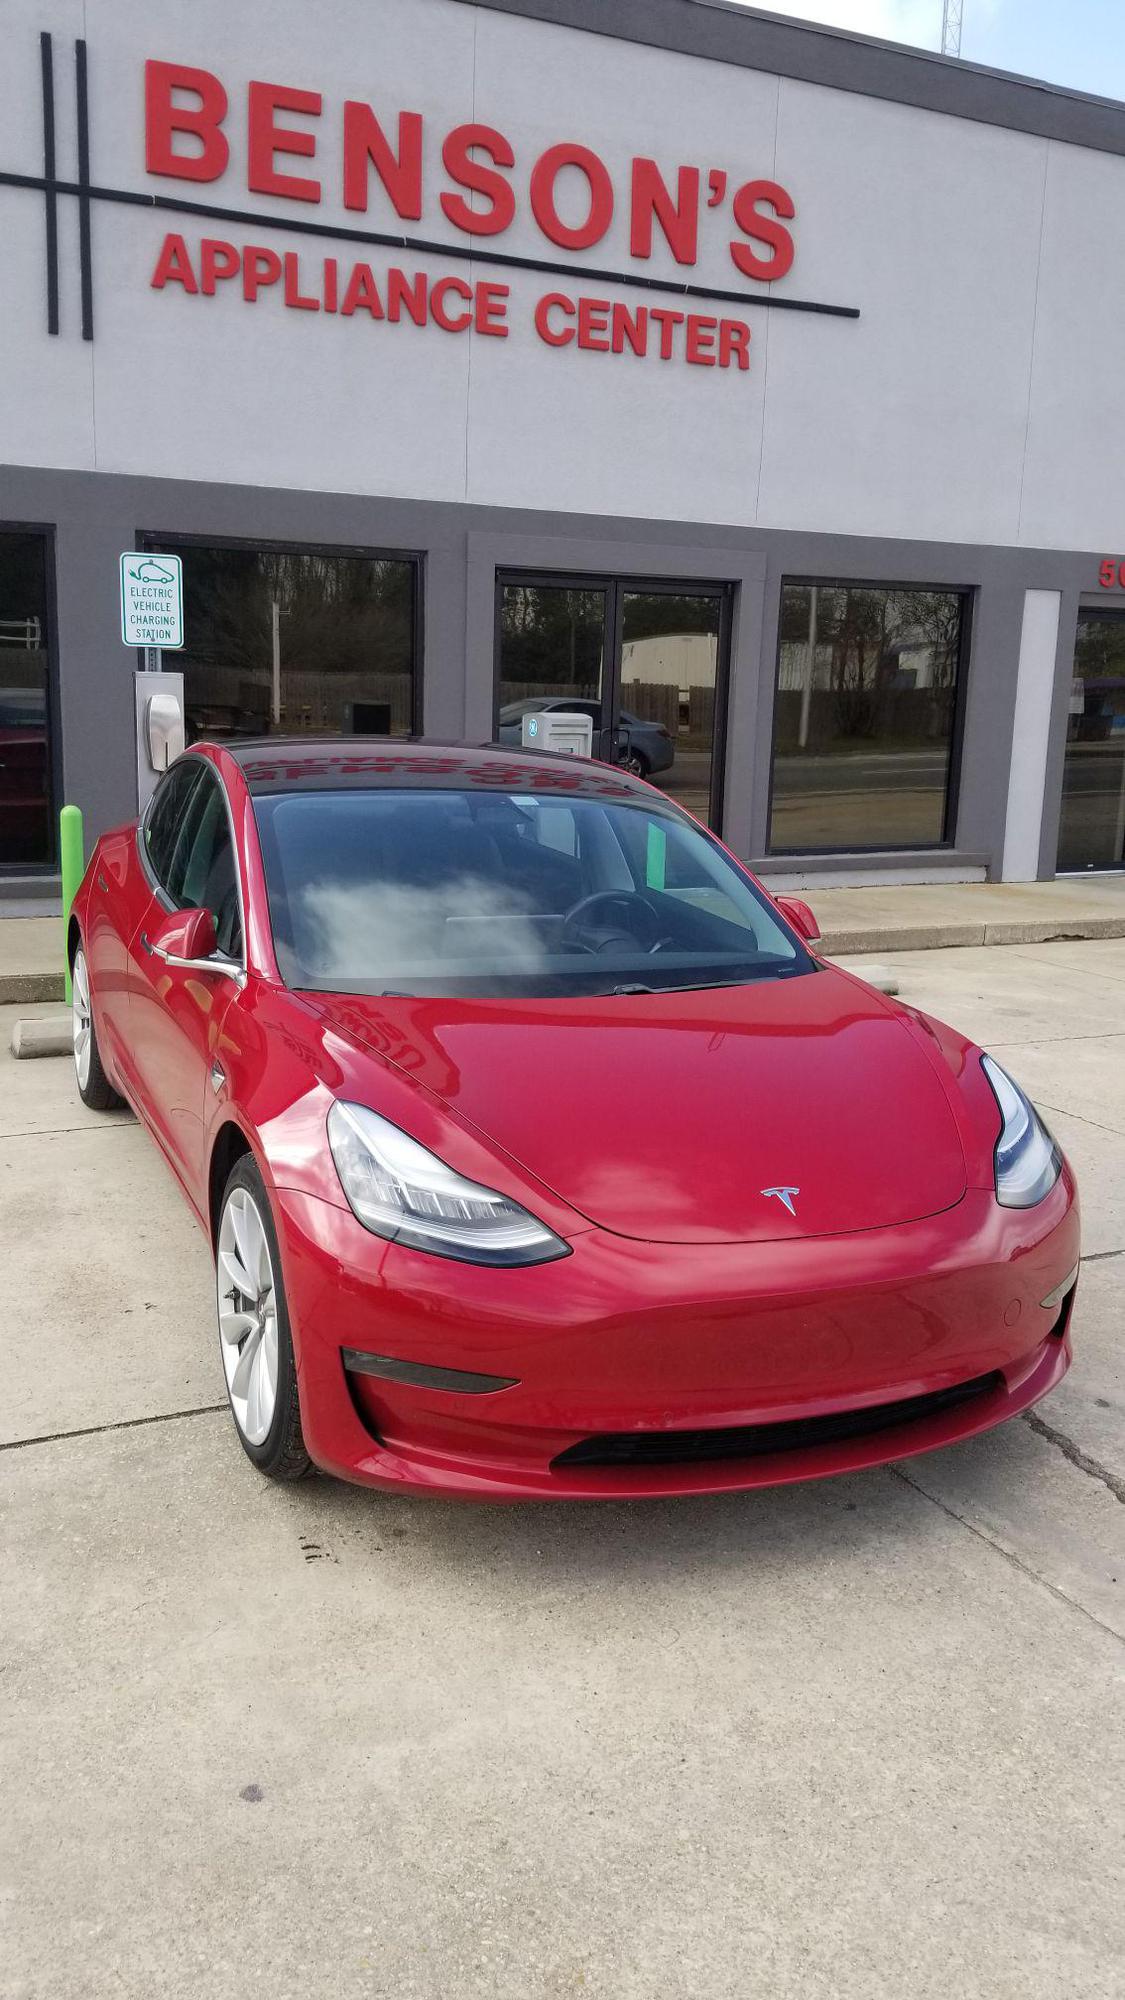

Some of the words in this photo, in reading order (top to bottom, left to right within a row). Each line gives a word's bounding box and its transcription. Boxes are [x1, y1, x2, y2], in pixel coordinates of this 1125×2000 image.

[144, 59, 796, 282] BENSON'S
[151, 233, 511, 337] APPLIANCE
[534, 292, 752, 370] CENTER
[130, 587, 173, 598] ELECTRIC
[133, 601, 171, 612] VEHICLE
[130, 614, 176, 626] CHARGING
[136, 628, 171, 639] STATION
